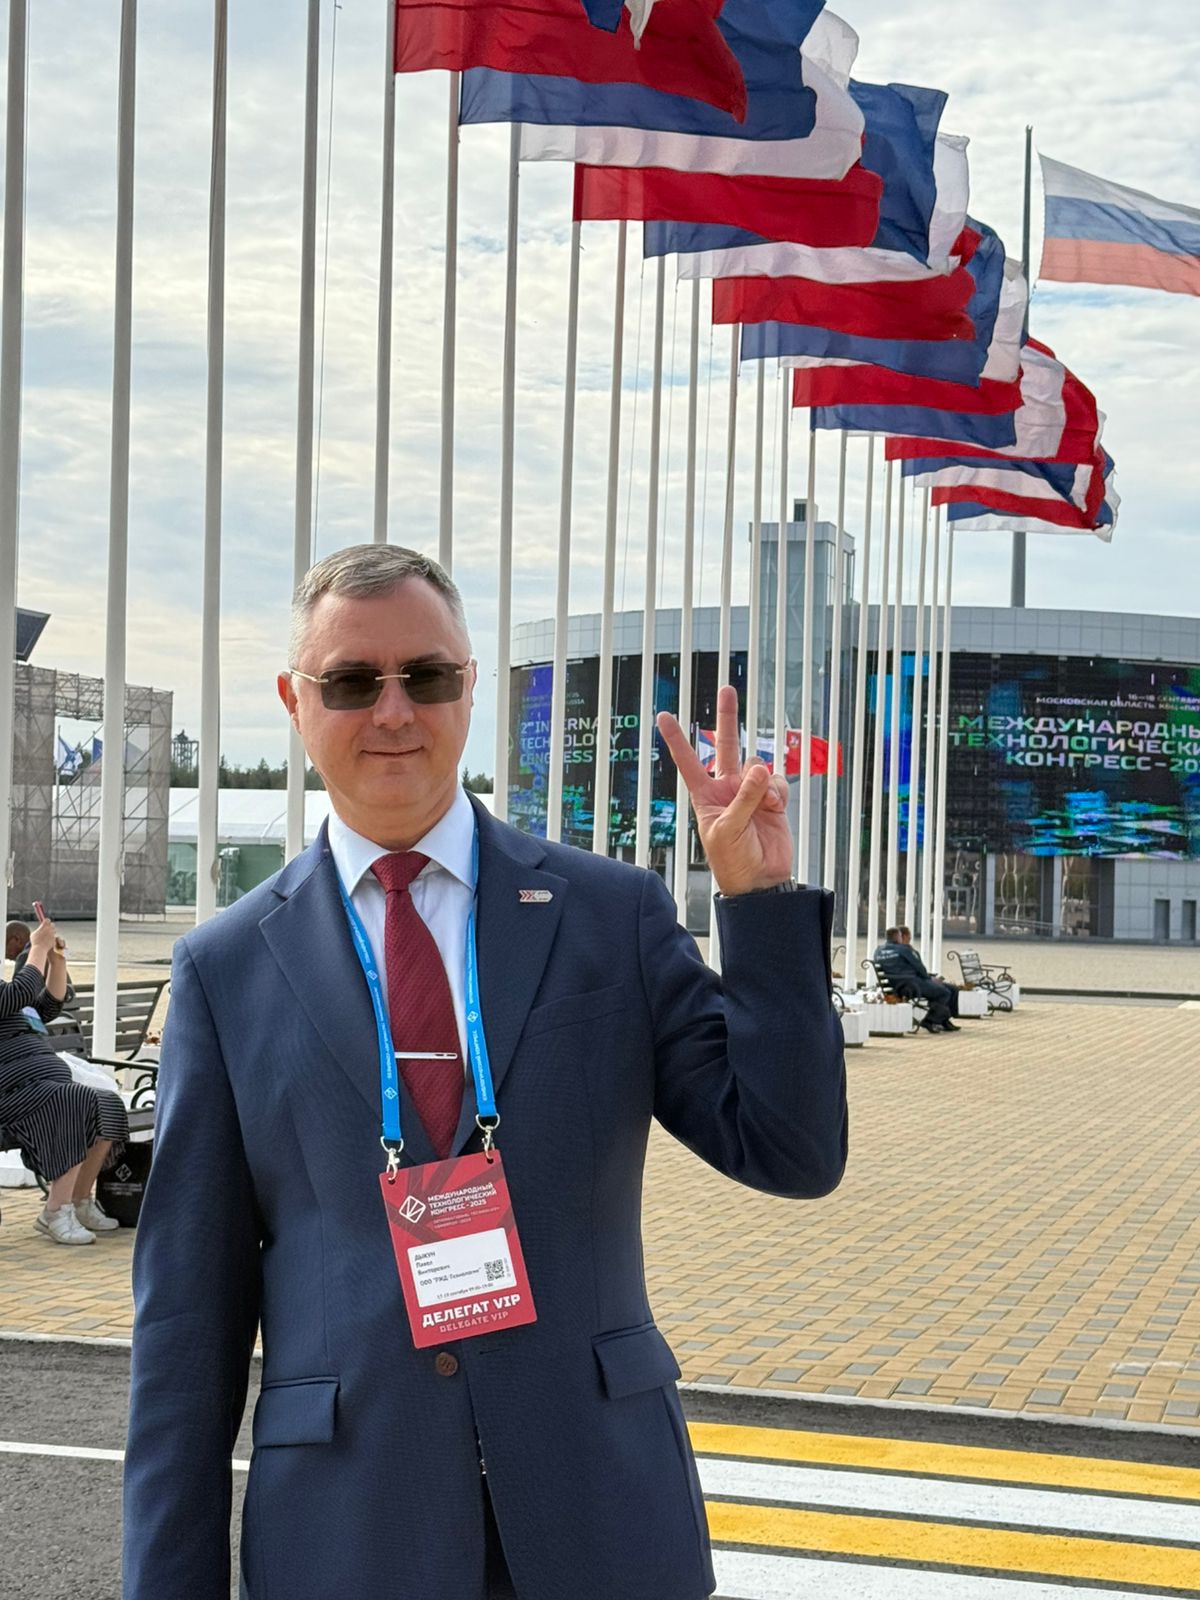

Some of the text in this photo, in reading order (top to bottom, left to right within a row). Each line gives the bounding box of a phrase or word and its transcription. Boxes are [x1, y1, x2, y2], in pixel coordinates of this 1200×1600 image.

[1036, 697, 1107, 707] МОСКОВСКАЯ
[428, 1182, 493, 1203] МЕЖДУНАРОДНЫЙ
[429, 1188, 497, 1210] ТЕХНОЛОГИЧЕСКИЙ
[422, 1293, 521, 1328] ДЕЛЕГАТ VIP
[440, 1311, 509, 1333] DELEGATE VIP
